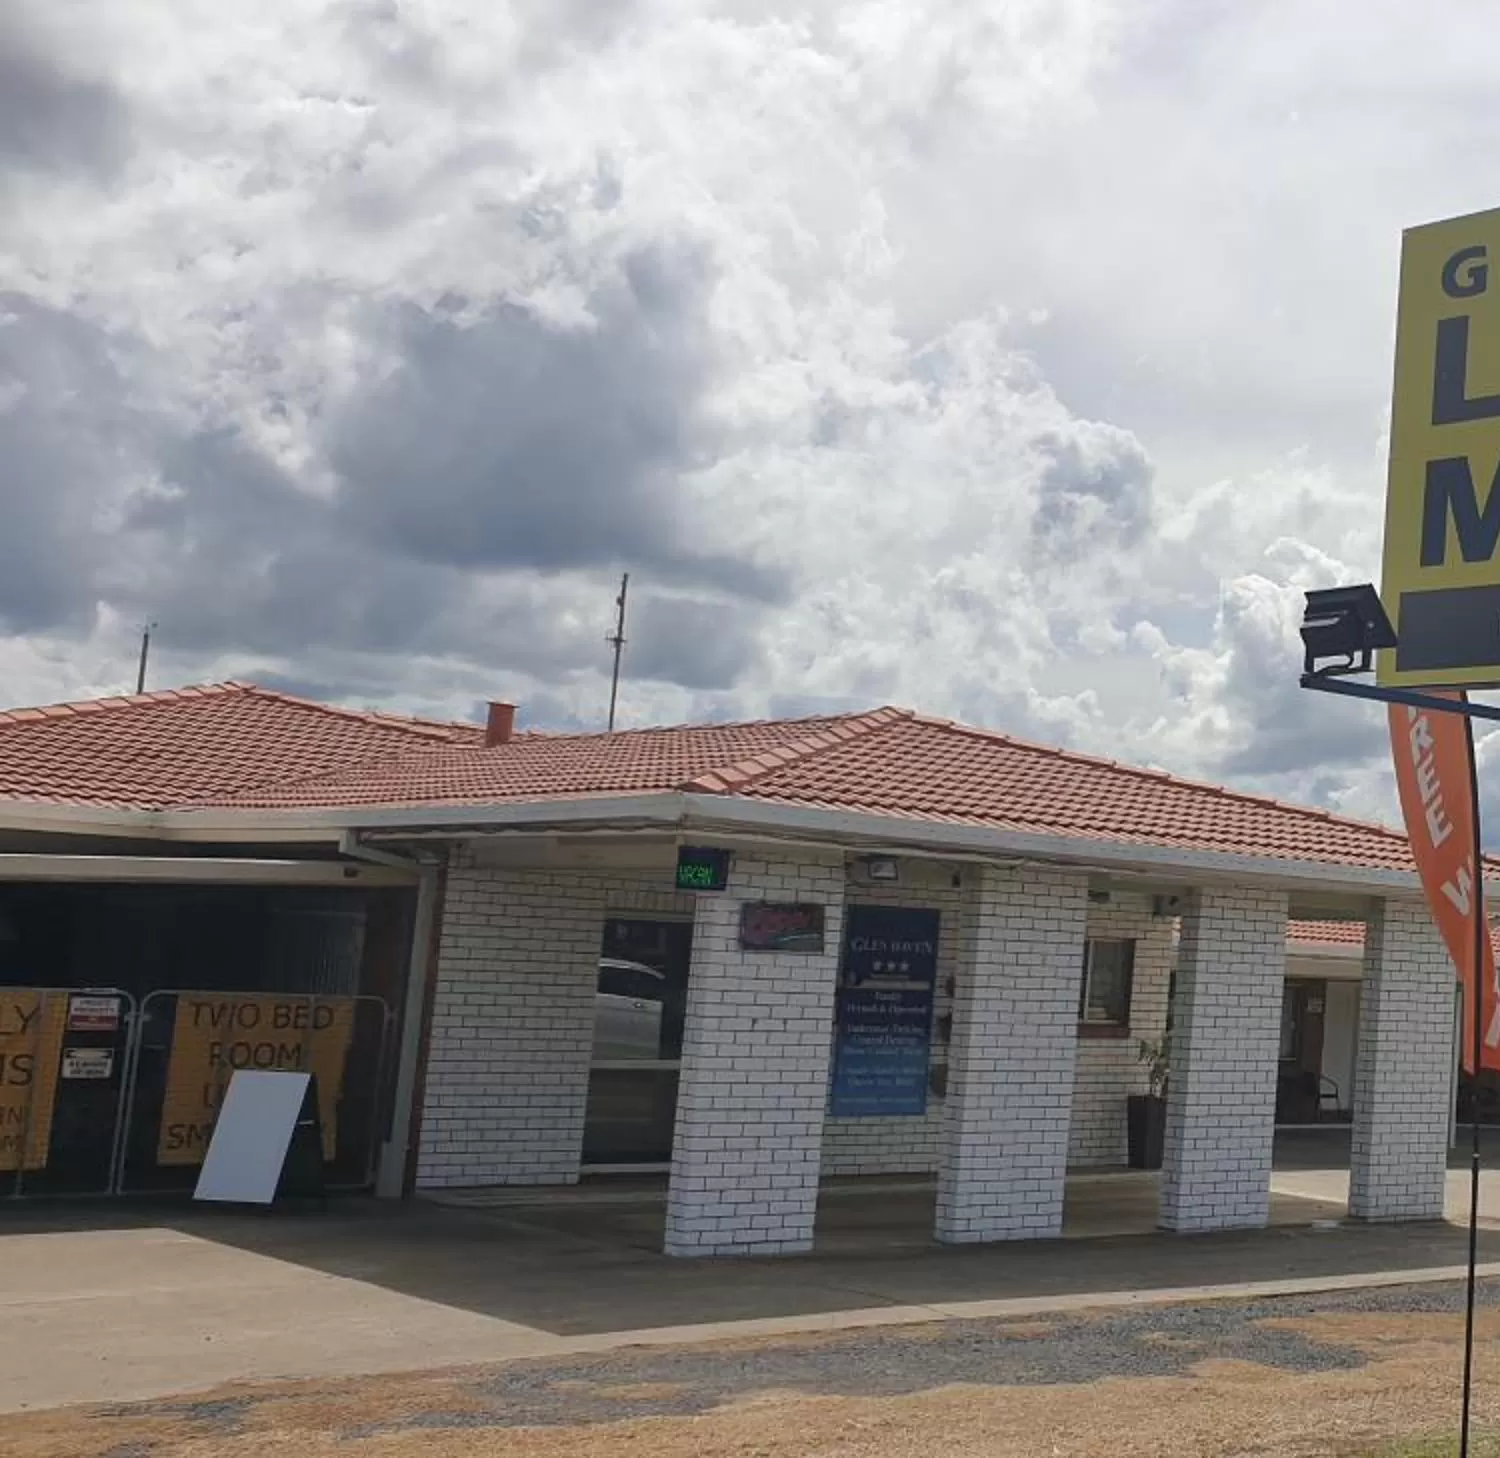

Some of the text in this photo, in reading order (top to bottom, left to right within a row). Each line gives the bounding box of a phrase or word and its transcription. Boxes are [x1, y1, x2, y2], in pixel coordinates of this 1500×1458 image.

[189, 1002, 336, 1030] TWO BED
[208, 1041, 304, 1068] ROOM
